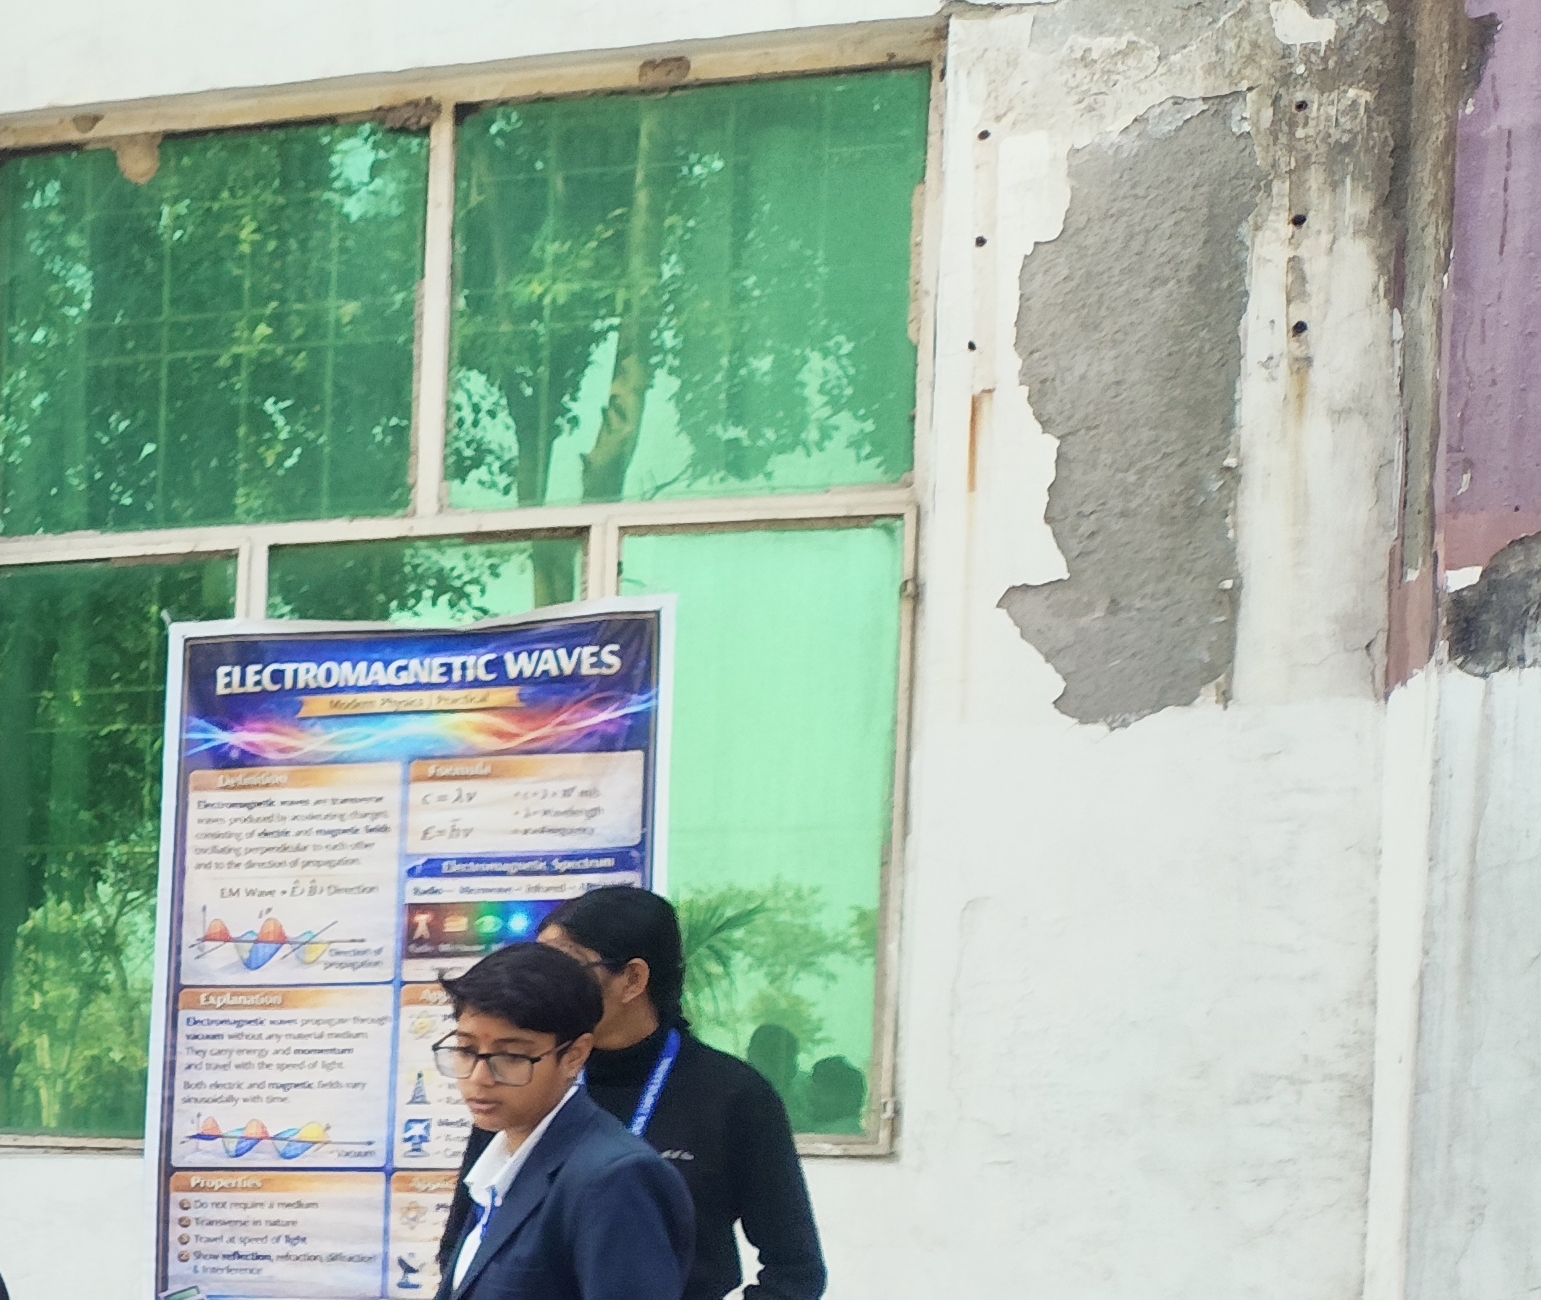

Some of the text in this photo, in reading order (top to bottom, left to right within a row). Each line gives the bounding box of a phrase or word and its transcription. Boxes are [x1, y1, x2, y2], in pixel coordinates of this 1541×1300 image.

[216, 644, 623, 696] ELECTROMAGNETIC WAVES
[220, 887, 240, 898] EM
[245, 887, 277, 898] Wave
[199, 992, 283, 1009] Explanation
[186, 1016, 266, 1028] Electromagnetic
[186, 1032, 224, 1041] vacuum
[227, 1031, 263, 1041] without
[234, 1060, 255, 1070] with
[257, 1060, 273, 1070] the
[190, 1175, 263, 1191] Properties
[194, 1200, 208, 1210] Do
[211, 1201, 228, 1210] not
[230, 1201, 266, 1212] require
[277, 1199, 319, 1209] medium
[194, 1234, 224, 1244] Travel
[238, 1234, 268, 1246] speed
[271, 1234, 282, 1244] of
[193, 1251, 220, 1261] Show
